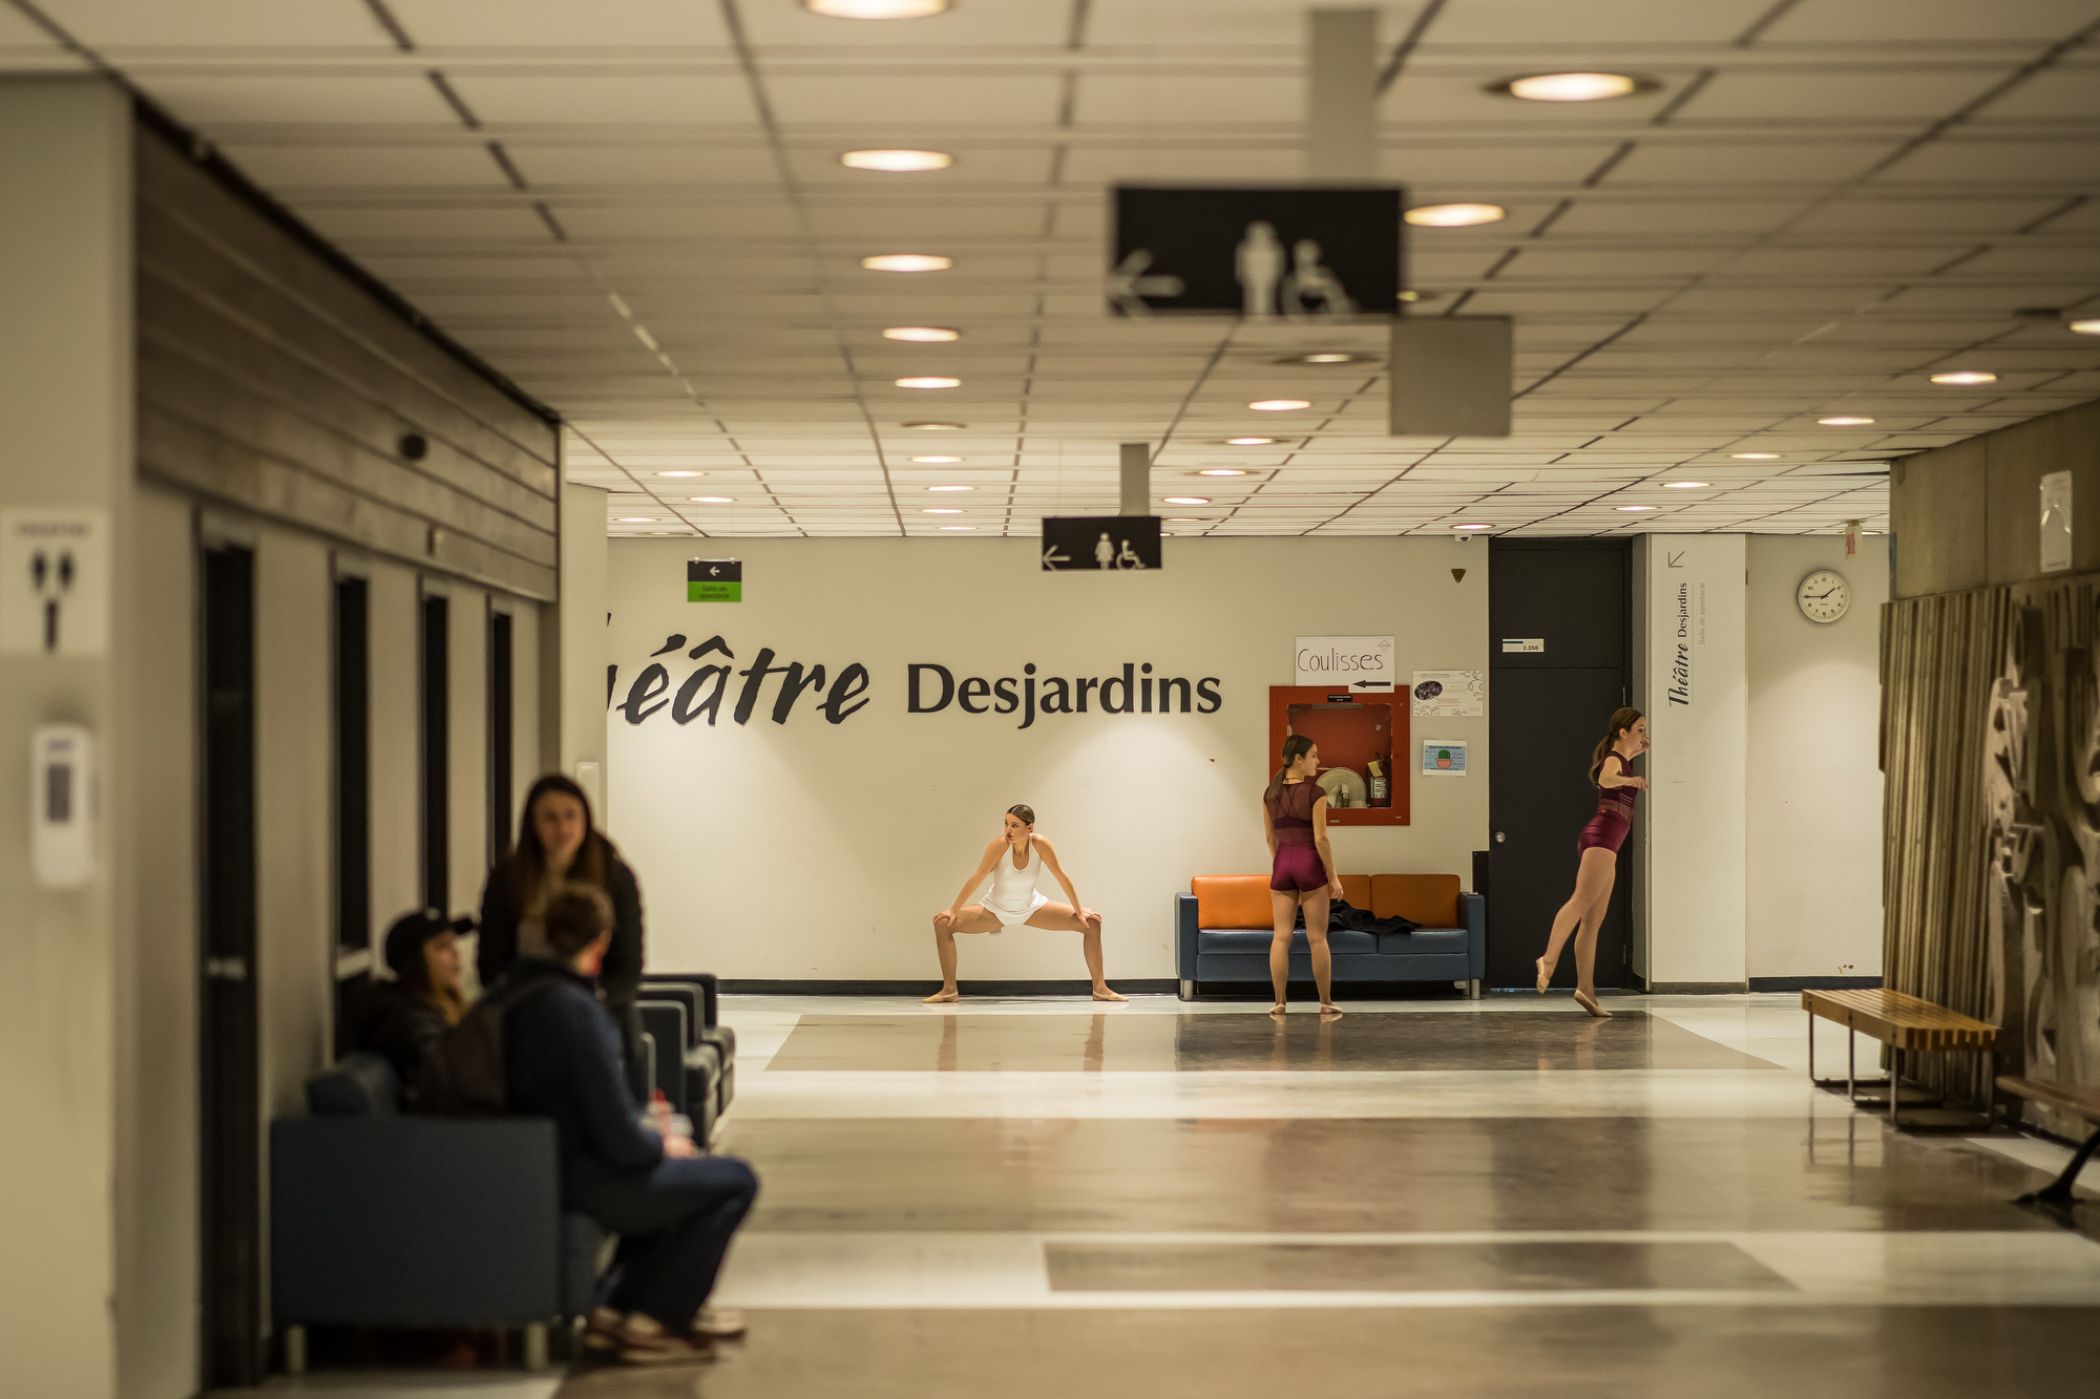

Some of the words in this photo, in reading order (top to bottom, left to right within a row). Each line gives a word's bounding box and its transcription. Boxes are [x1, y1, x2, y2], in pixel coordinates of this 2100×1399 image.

[1677, 582, 1689, 638] Desjardins
[607, 613, 870, 727] éâtre
[907, 662, 1222, 729] Desjardins
[1297, 648, 1384, 672] Coulisses
[1667, 643, 1689, 707] Théâtre
